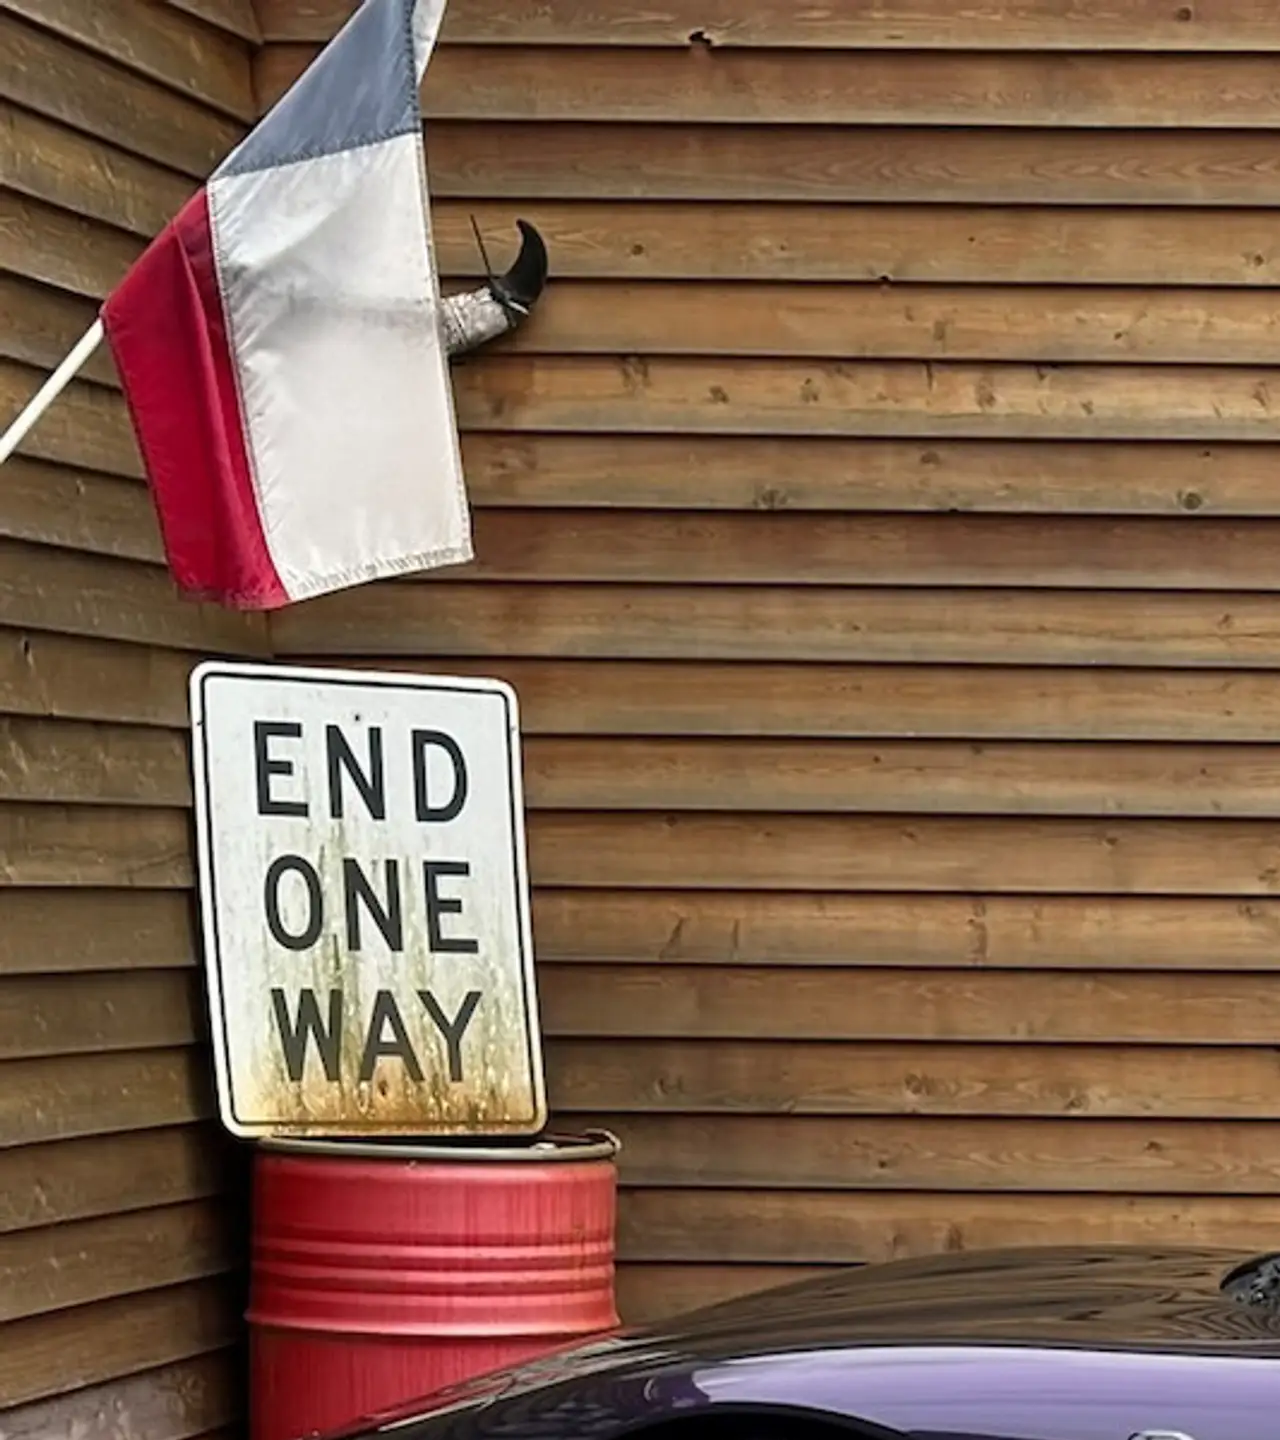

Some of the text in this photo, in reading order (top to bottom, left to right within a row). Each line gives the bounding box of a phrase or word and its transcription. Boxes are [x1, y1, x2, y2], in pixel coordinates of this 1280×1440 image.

[253, 720, 468, 823] END
[263, 853, 479, 954] ONE
[270, 988, 483, 1083] WAY
